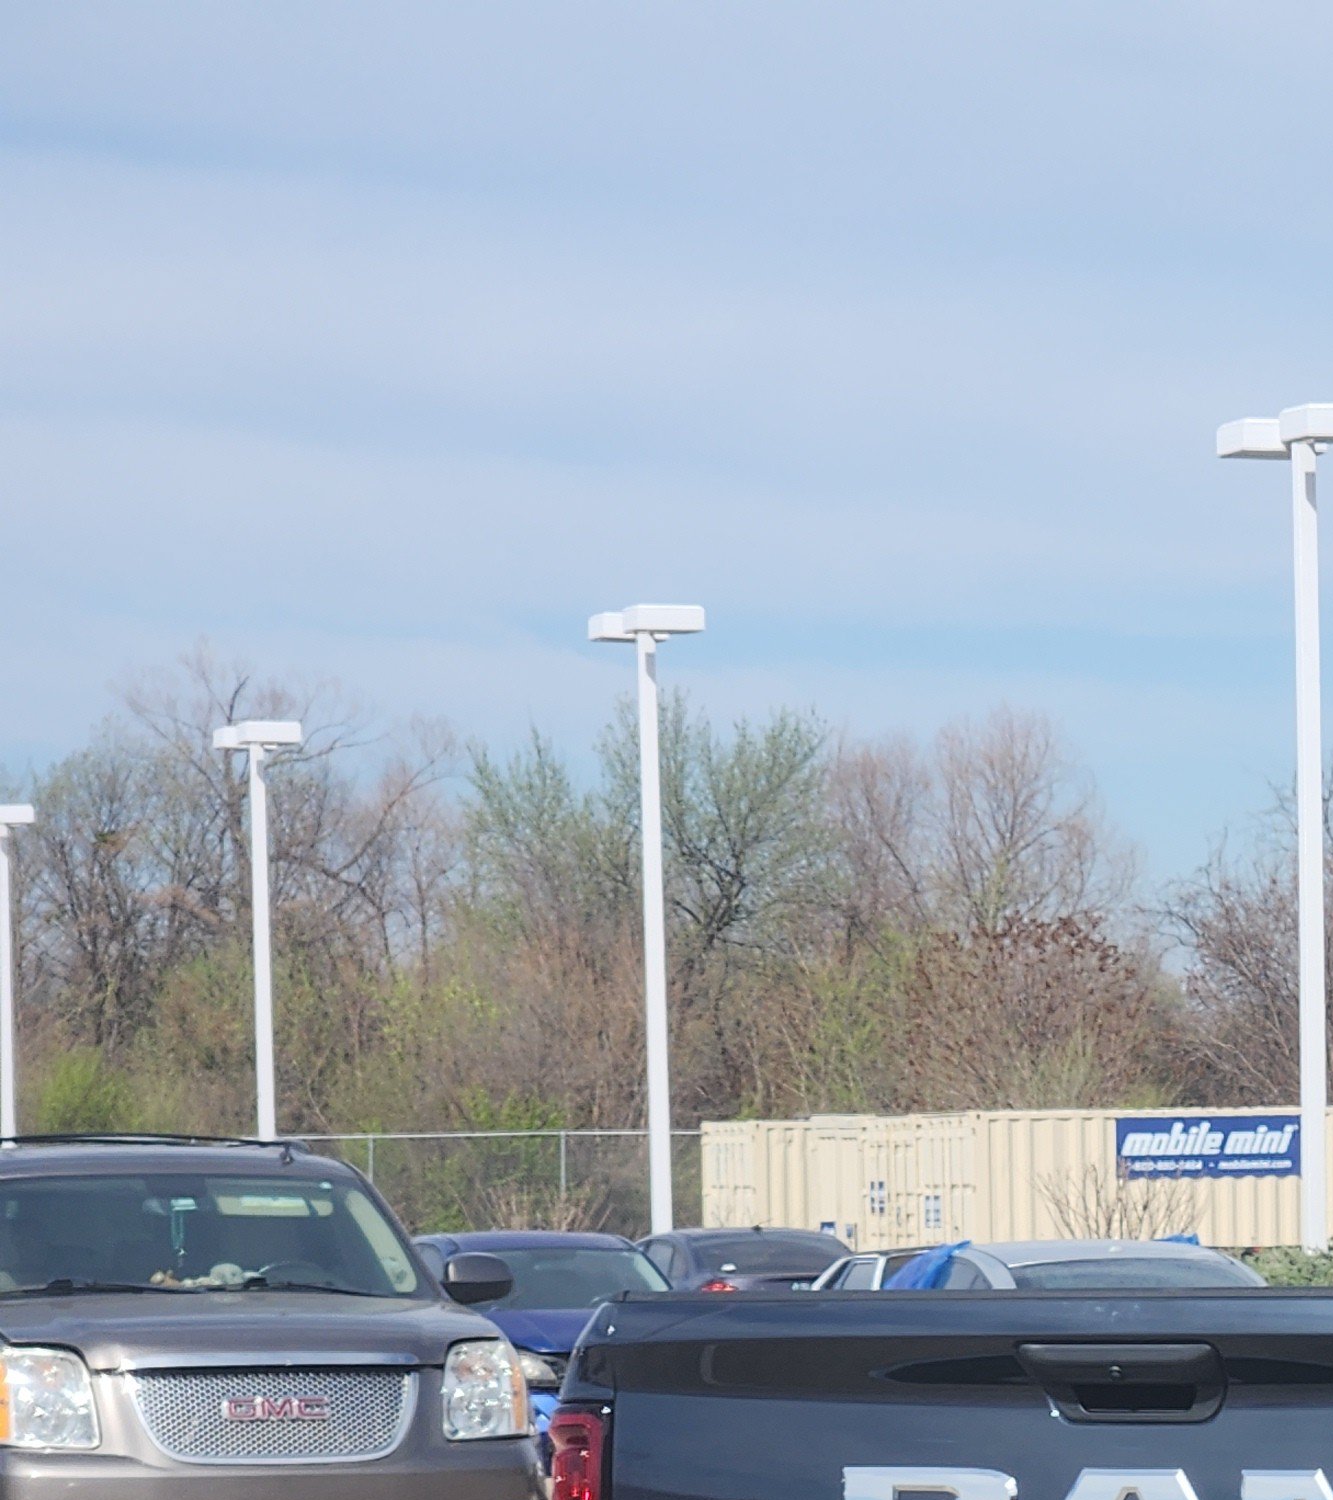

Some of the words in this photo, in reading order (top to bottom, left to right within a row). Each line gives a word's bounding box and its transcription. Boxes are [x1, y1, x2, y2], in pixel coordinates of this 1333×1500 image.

[1121, 1120, 1224, 1156] mobile
[1223, 1124, 1296, 1155] mini
[222, 1396, 329, 1421] GMC
